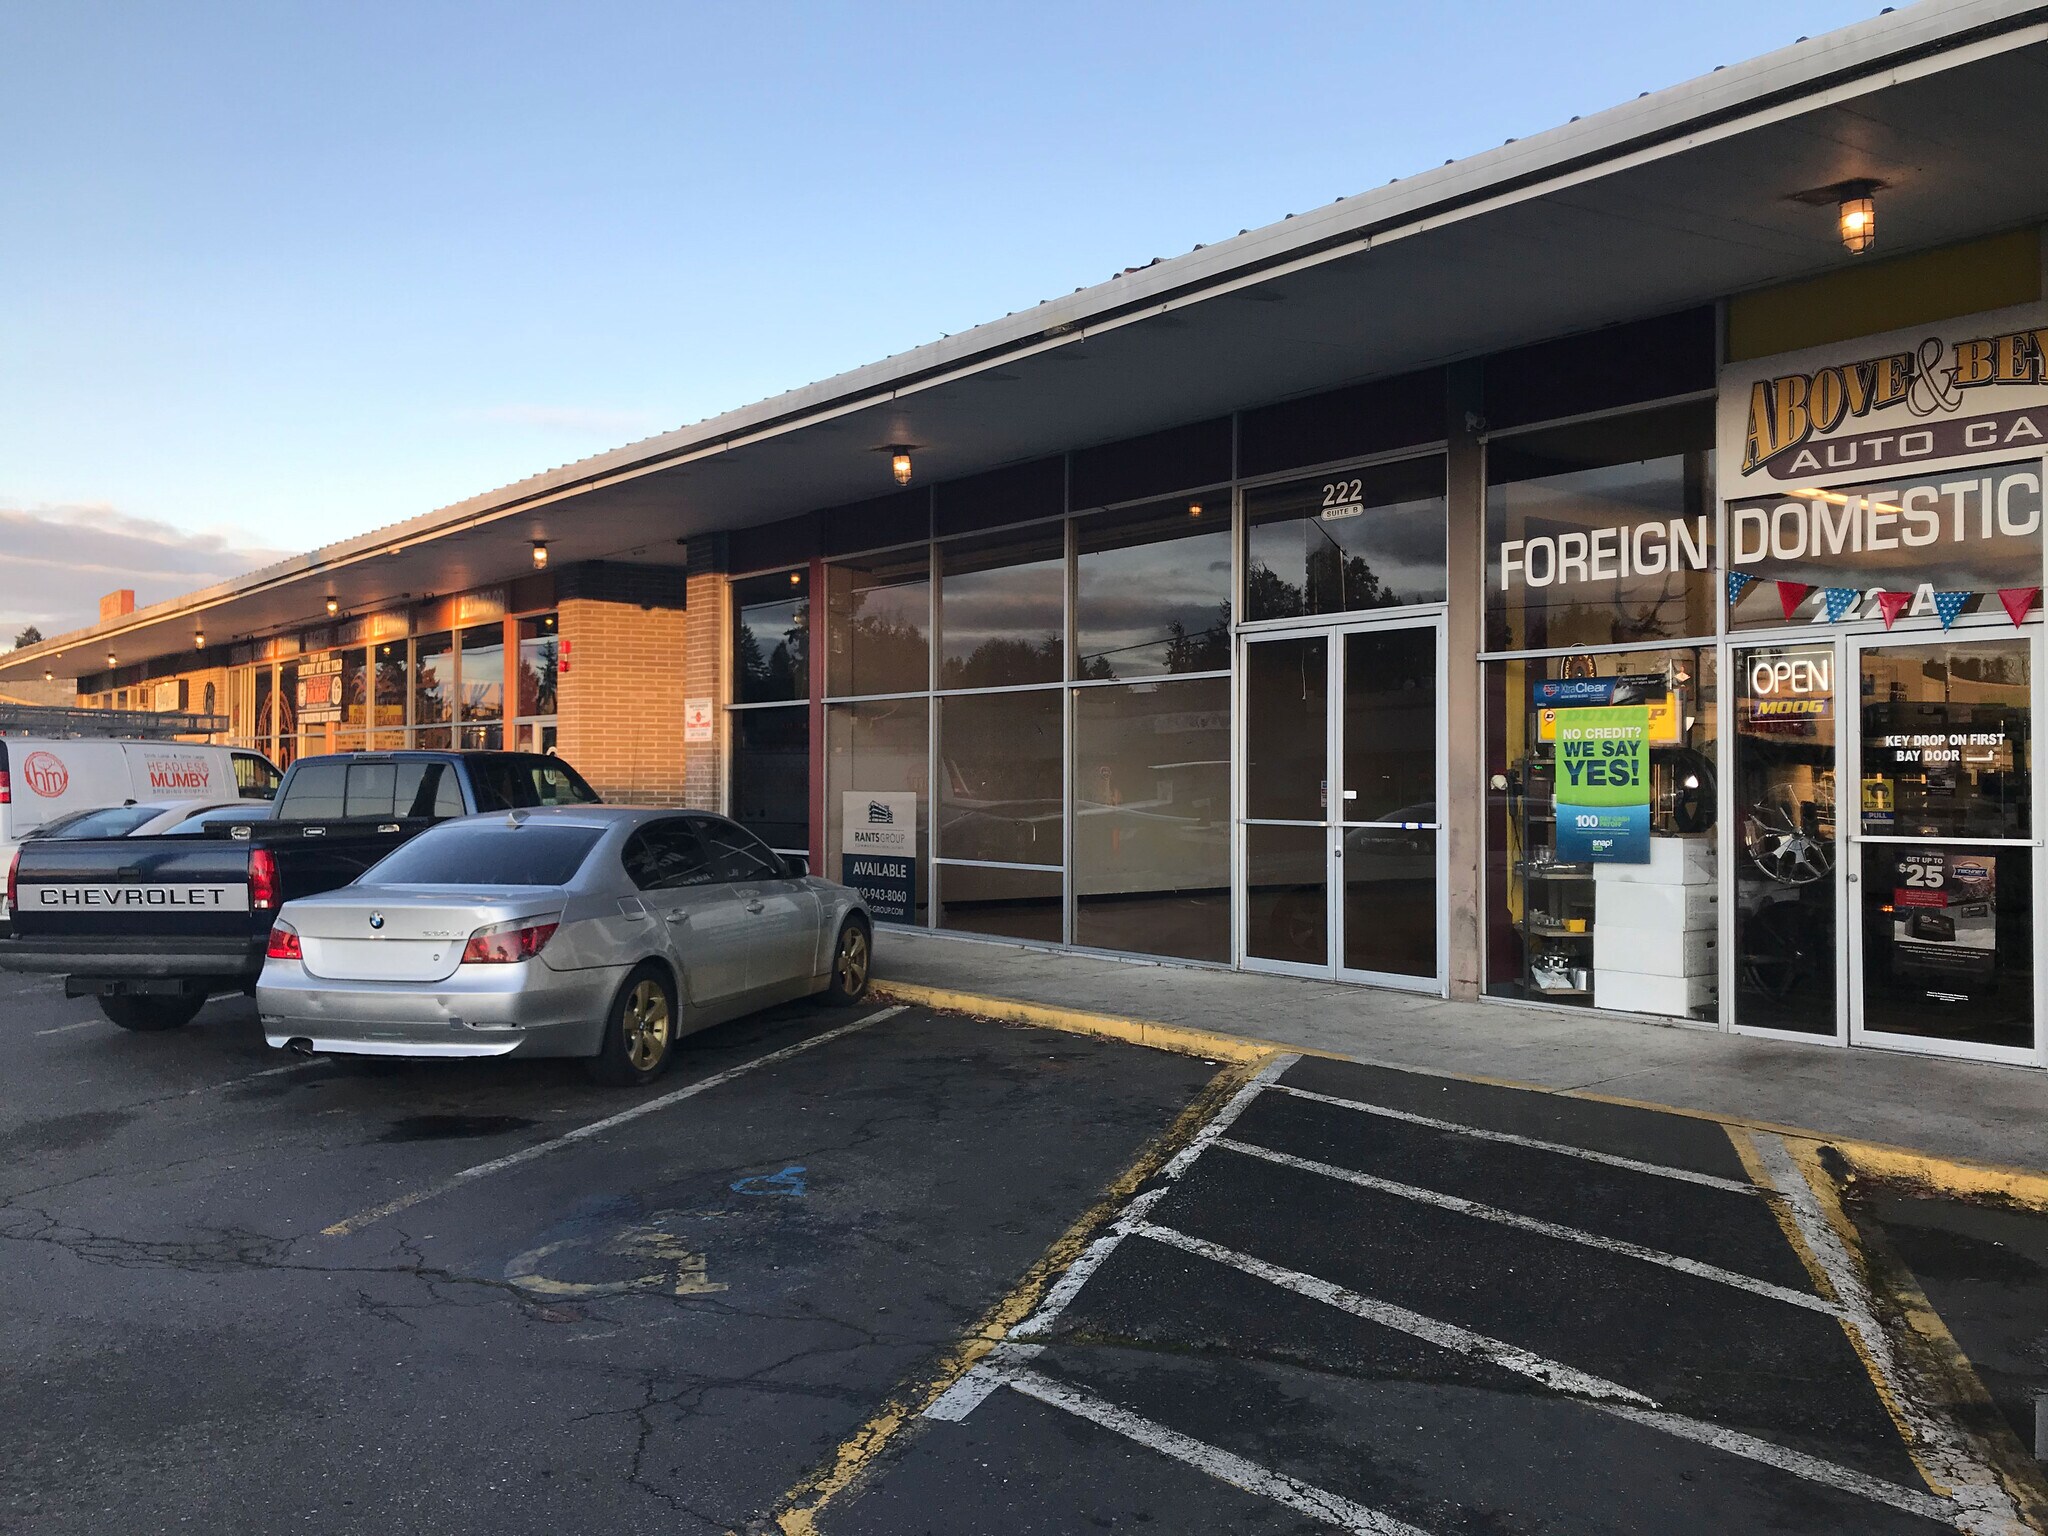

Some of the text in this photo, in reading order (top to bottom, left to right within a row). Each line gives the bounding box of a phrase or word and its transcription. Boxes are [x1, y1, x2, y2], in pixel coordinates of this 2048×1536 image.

[1741, 351, 1915, 477] ABOVE
[1907, 337, 1963, 417] &
[1789, 431, 1934, 474] AUTO
[1322, 479, 1362, 506] 222
[1326, 508, 1349, 517] SUITE
[1501, 473, 2040, 591] FOREIGN DOMESTIC
[1752, 659, 1829, 695] OPEN
[1561, 682, 1607, 693] XtraClear
[1757, 700, 1825, 715] MOOG
[1563, 727, 1642, 740] NO CREDIT?
[1886, 733, 2005, 747] KEY DROP ON FIRST
[1564, 740, 1641, 757] WE SAY
[1896, 750, 1960, 762] BAY DOOR
[147, 761, 209, 773] HEADLESS
[1563, 759, 1639, 787] YES!
[150, 772, 209, 787] MUMBY
[1576, 815, 1598, 827] 100
[1592, 839, 1612, 848] snap!
[853, 862, 907, 878] AVAILABLE
[40, 888, 225, 905] CHEVROLET
